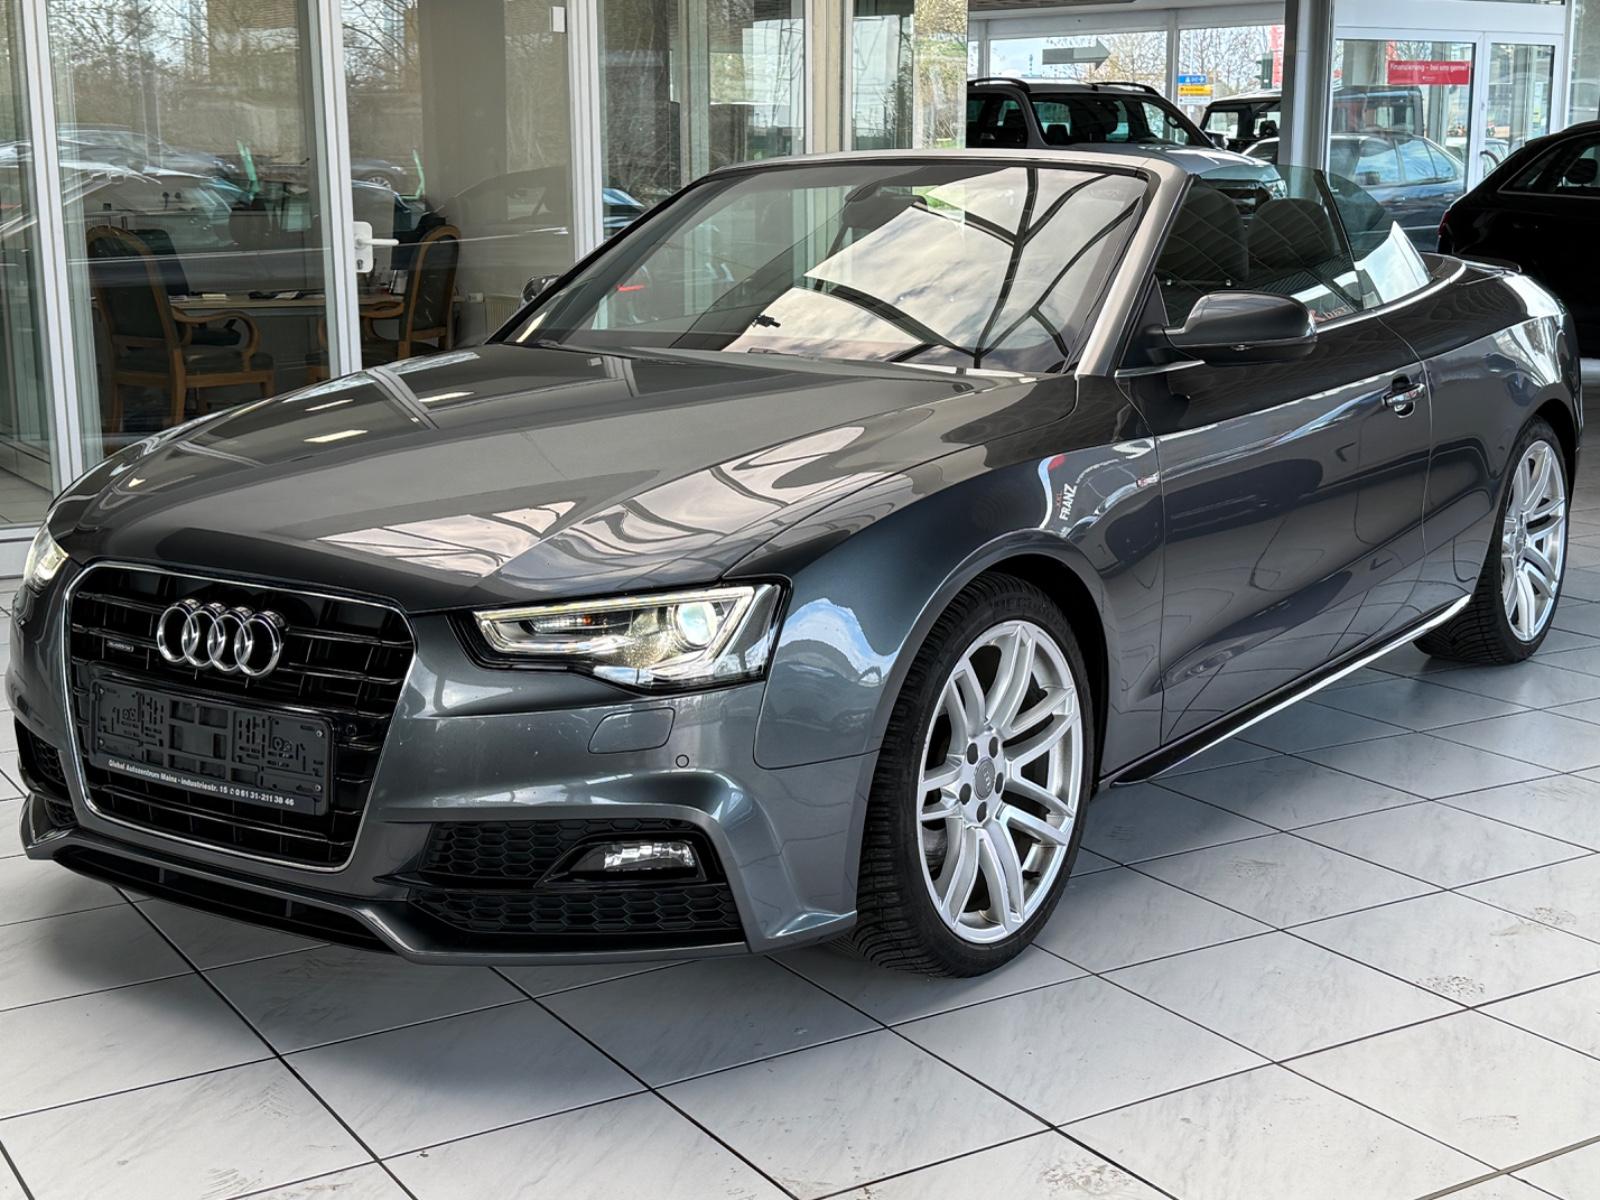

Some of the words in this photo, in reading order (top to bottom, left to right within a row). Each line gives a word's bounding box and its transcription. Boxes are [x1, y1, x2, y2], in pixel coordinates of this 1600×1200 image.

[1058, 483, 1078, 521] FRANZ
[108, 759, 126, 771] Global
[126, 764, 160, 780] Autozentrum
[160, 772, 178, 784] Mainz
